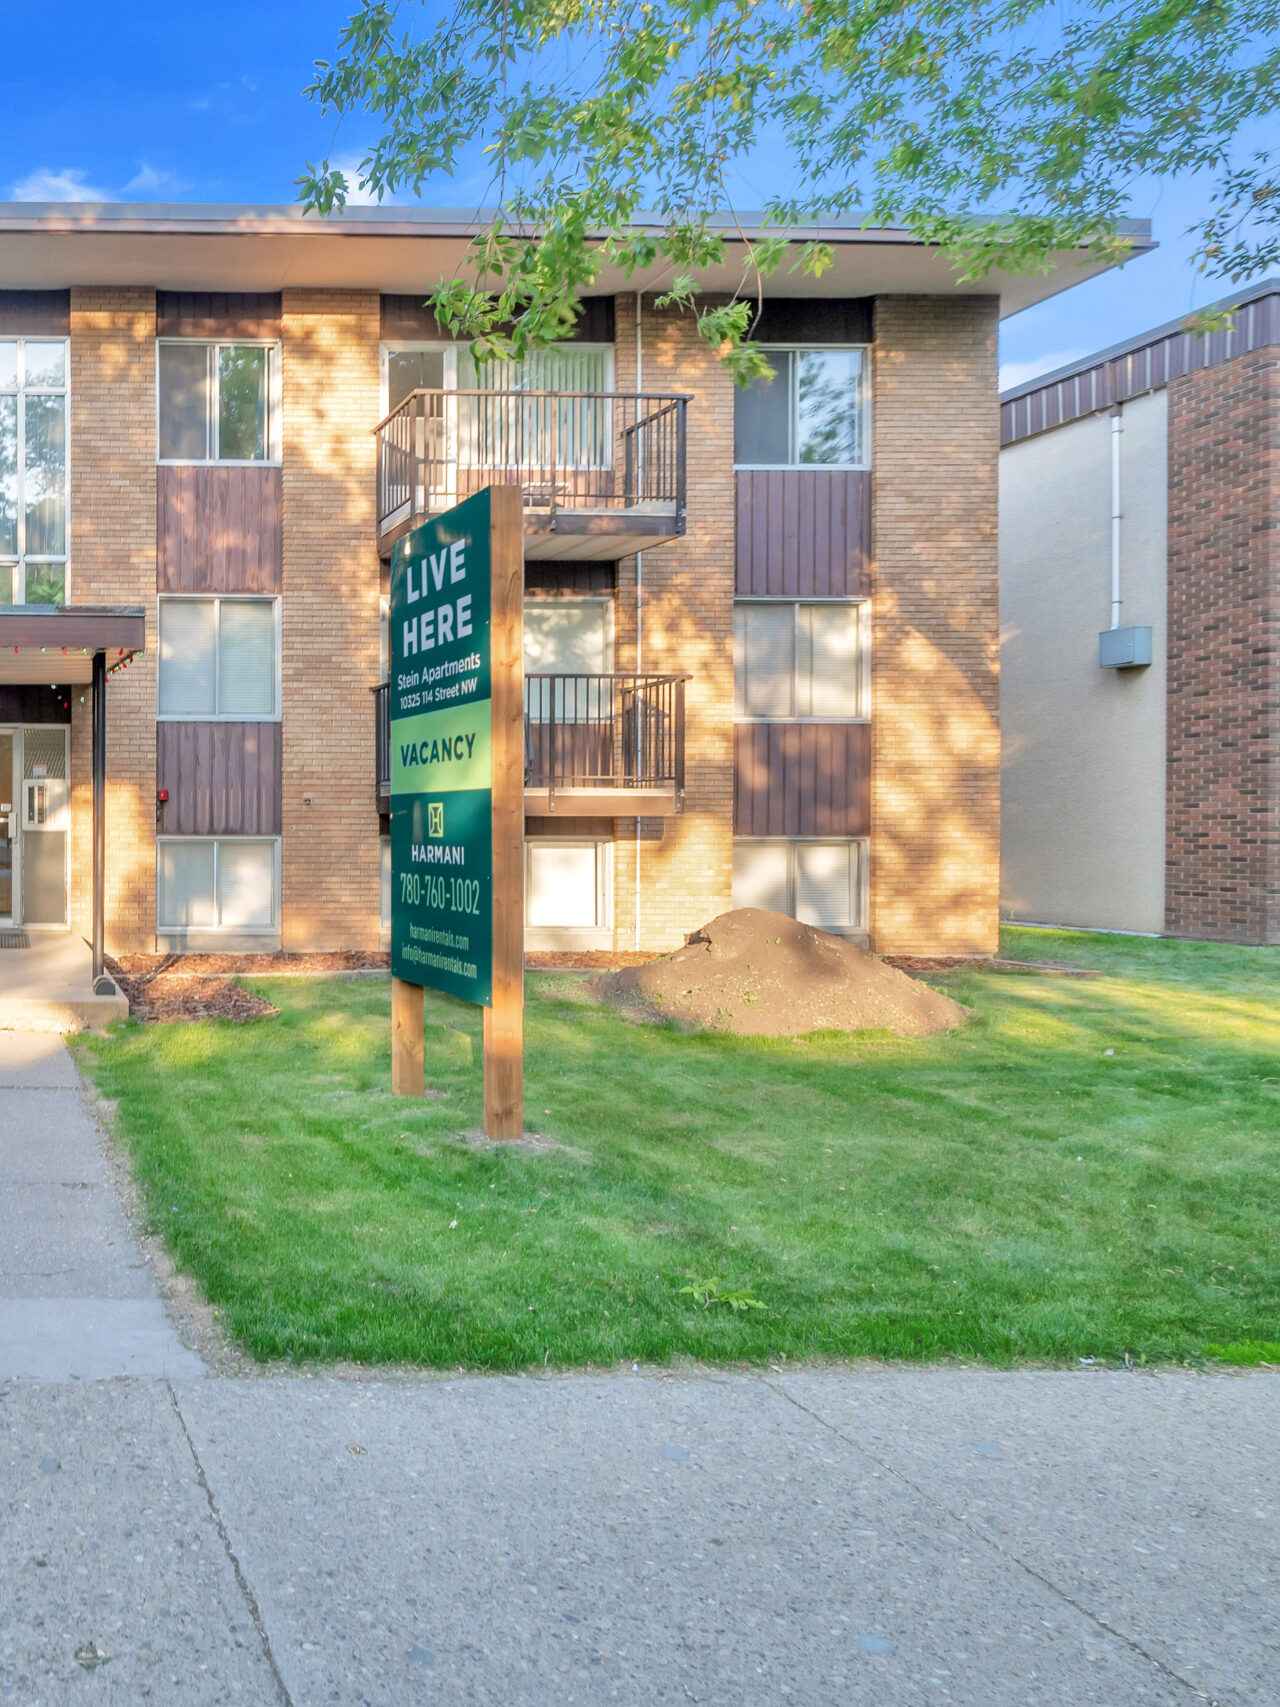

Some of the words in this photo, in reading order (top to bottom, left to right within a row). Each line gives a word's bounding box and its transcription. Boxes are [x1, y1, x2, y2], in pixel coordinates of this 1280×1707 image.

[407, 538, 466, 604] LIVE
[403, 594, 473, 657] HERE
[397, 670, 419, 690] Stein
[422, 652, 480, 685] Apartments
[400, 693, 420, 710] 10325
[422, 690, 433, 704] 114
[435, 683, 460, 702] Street
[461, 678, 477, 695] NW
[400, 733, 476, 767] VACANCY
[411, 844, 465, 865] HARMANI
[400, 873, 480, 915] 780-760-1002
[409, 922, 469, 951] harmanirentals.com
[402, 943, 477, 979] info@harmanirentals.com
